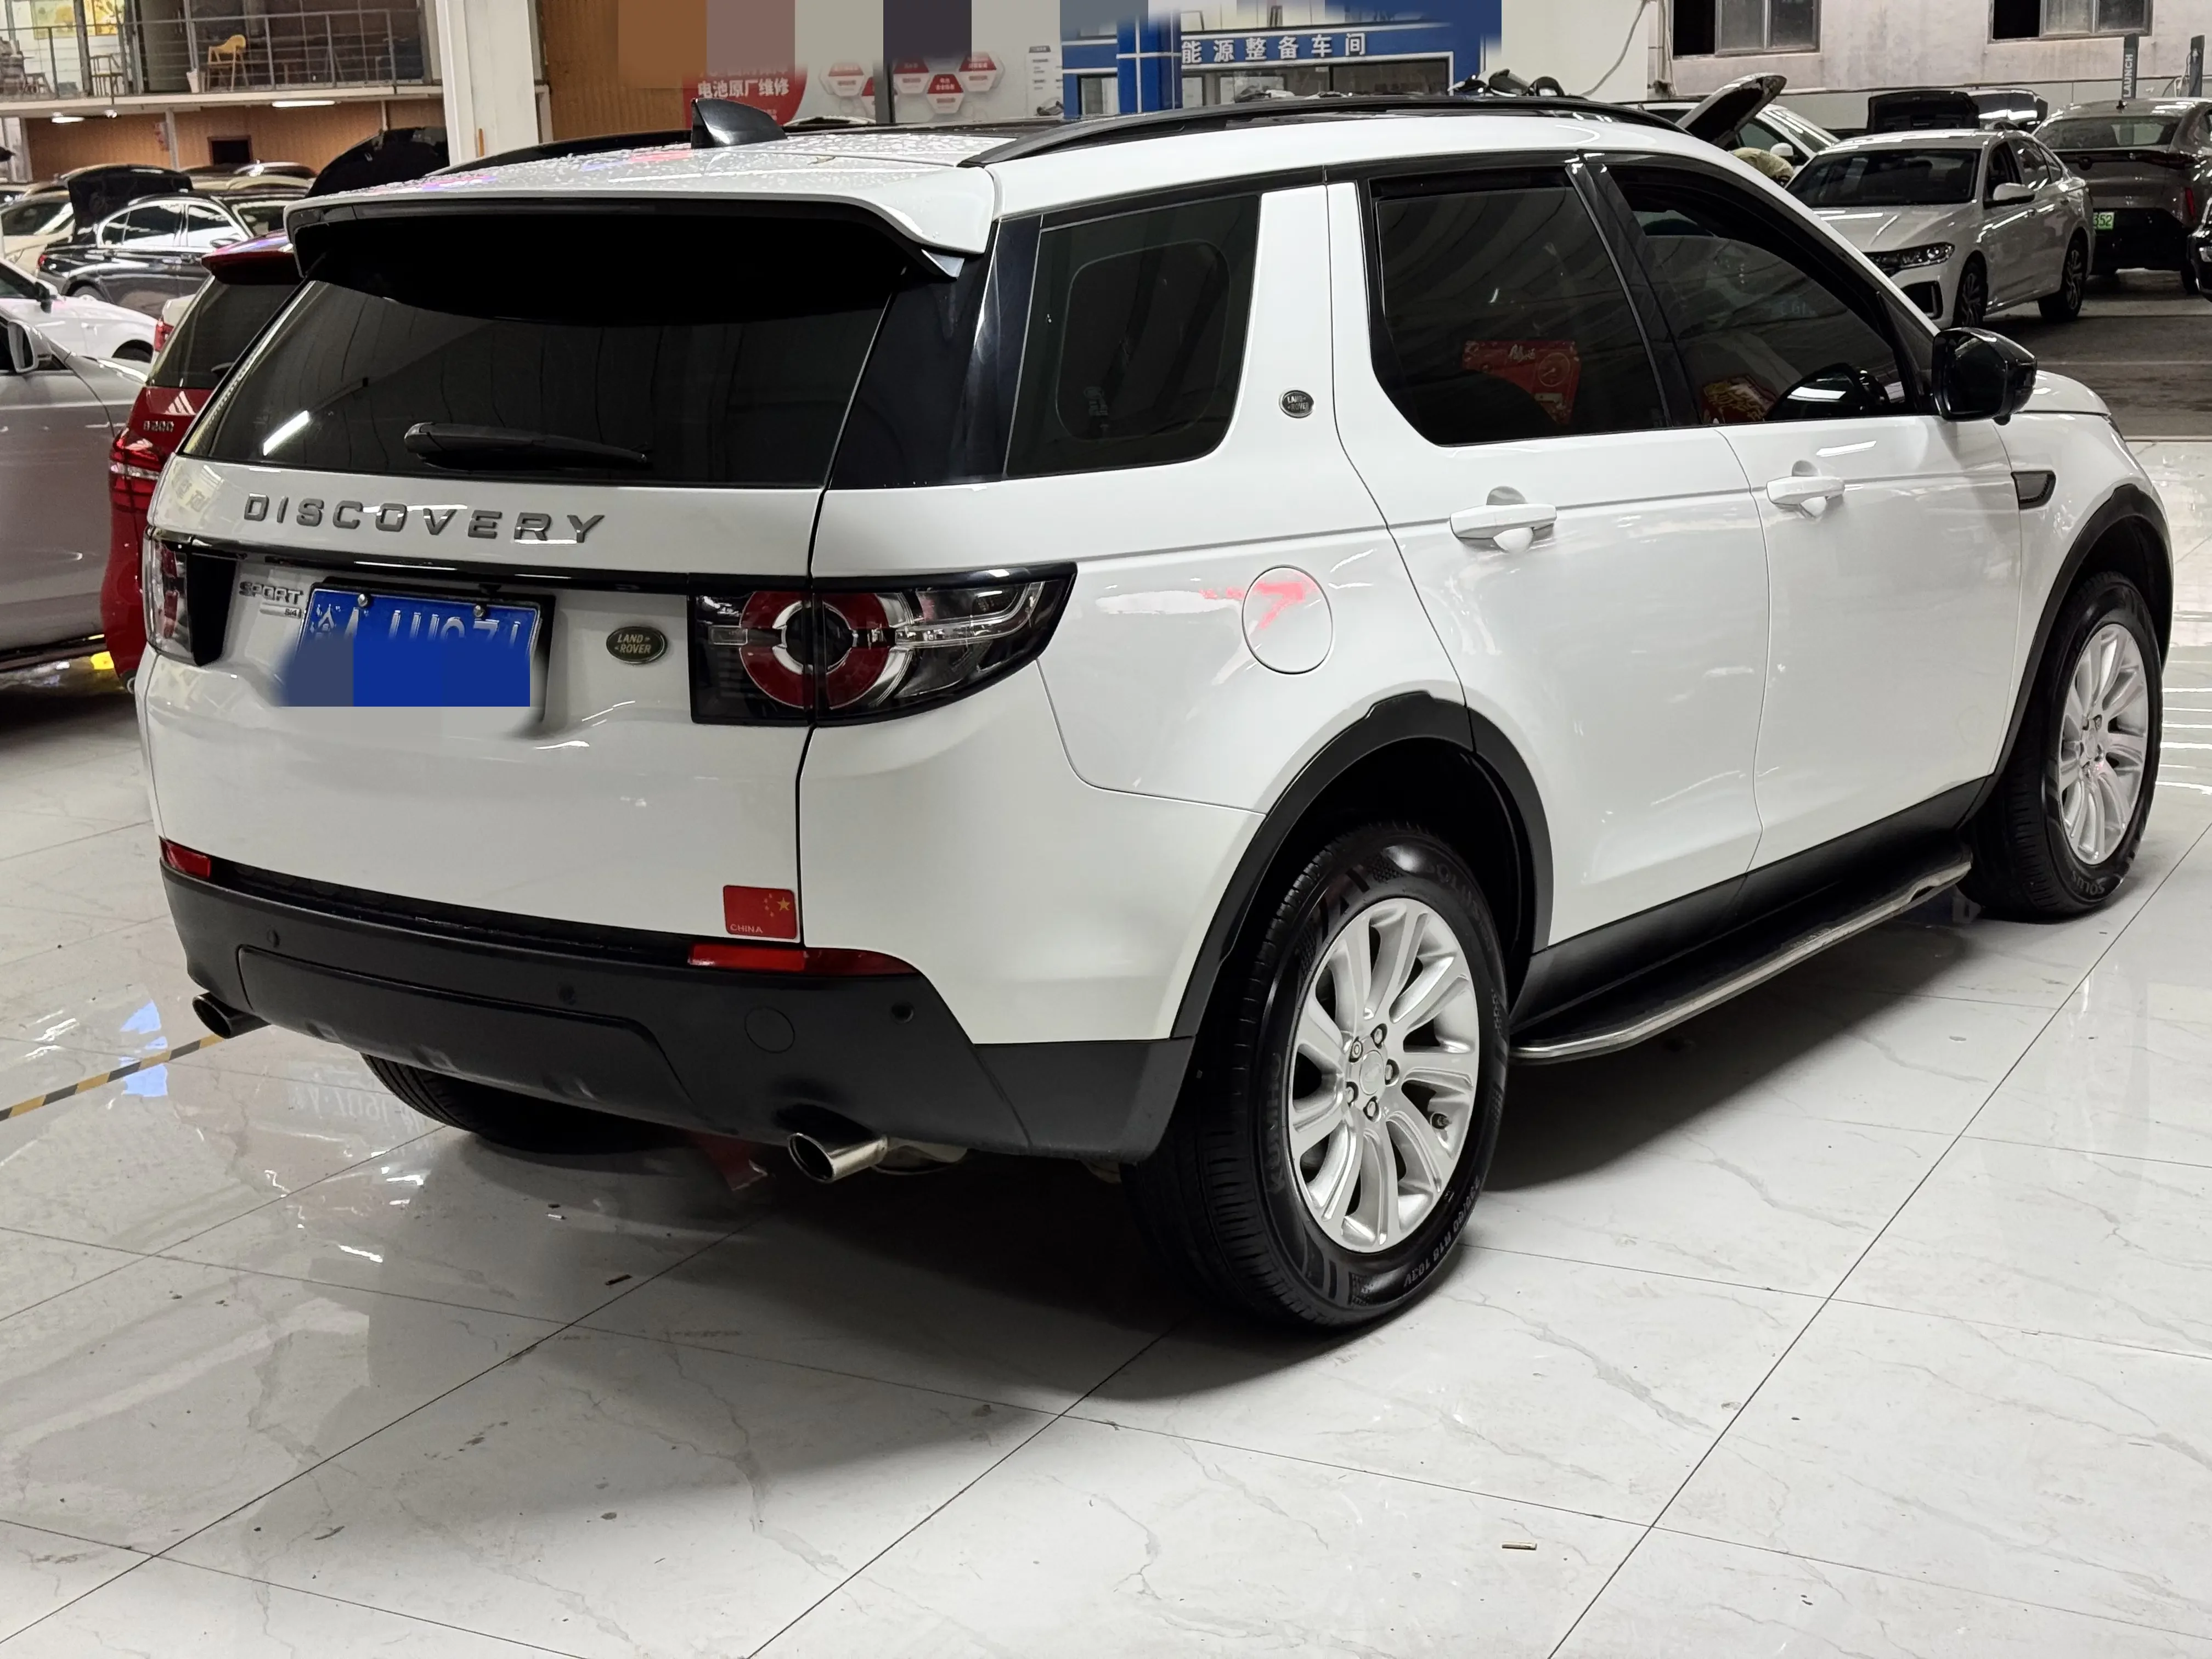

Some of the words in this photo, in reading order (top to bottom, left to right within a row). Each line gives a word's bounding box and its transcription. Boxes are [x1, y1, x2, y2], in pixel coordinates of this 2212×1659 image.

[1182, 33, 1367, 64] 能源整备车间
[2123, 54, 2134, 98] LAUNCH
[698, 78, 789, 98] 电池原厂维修
[244, 493, 605, 544] DISCOVERY
[239, 582, 303, 604] SPORT
[617, 634, 644, 644] LAND
[620, 644, 652, 654] ROVER
[730, 924, 763, 933] CHINA
